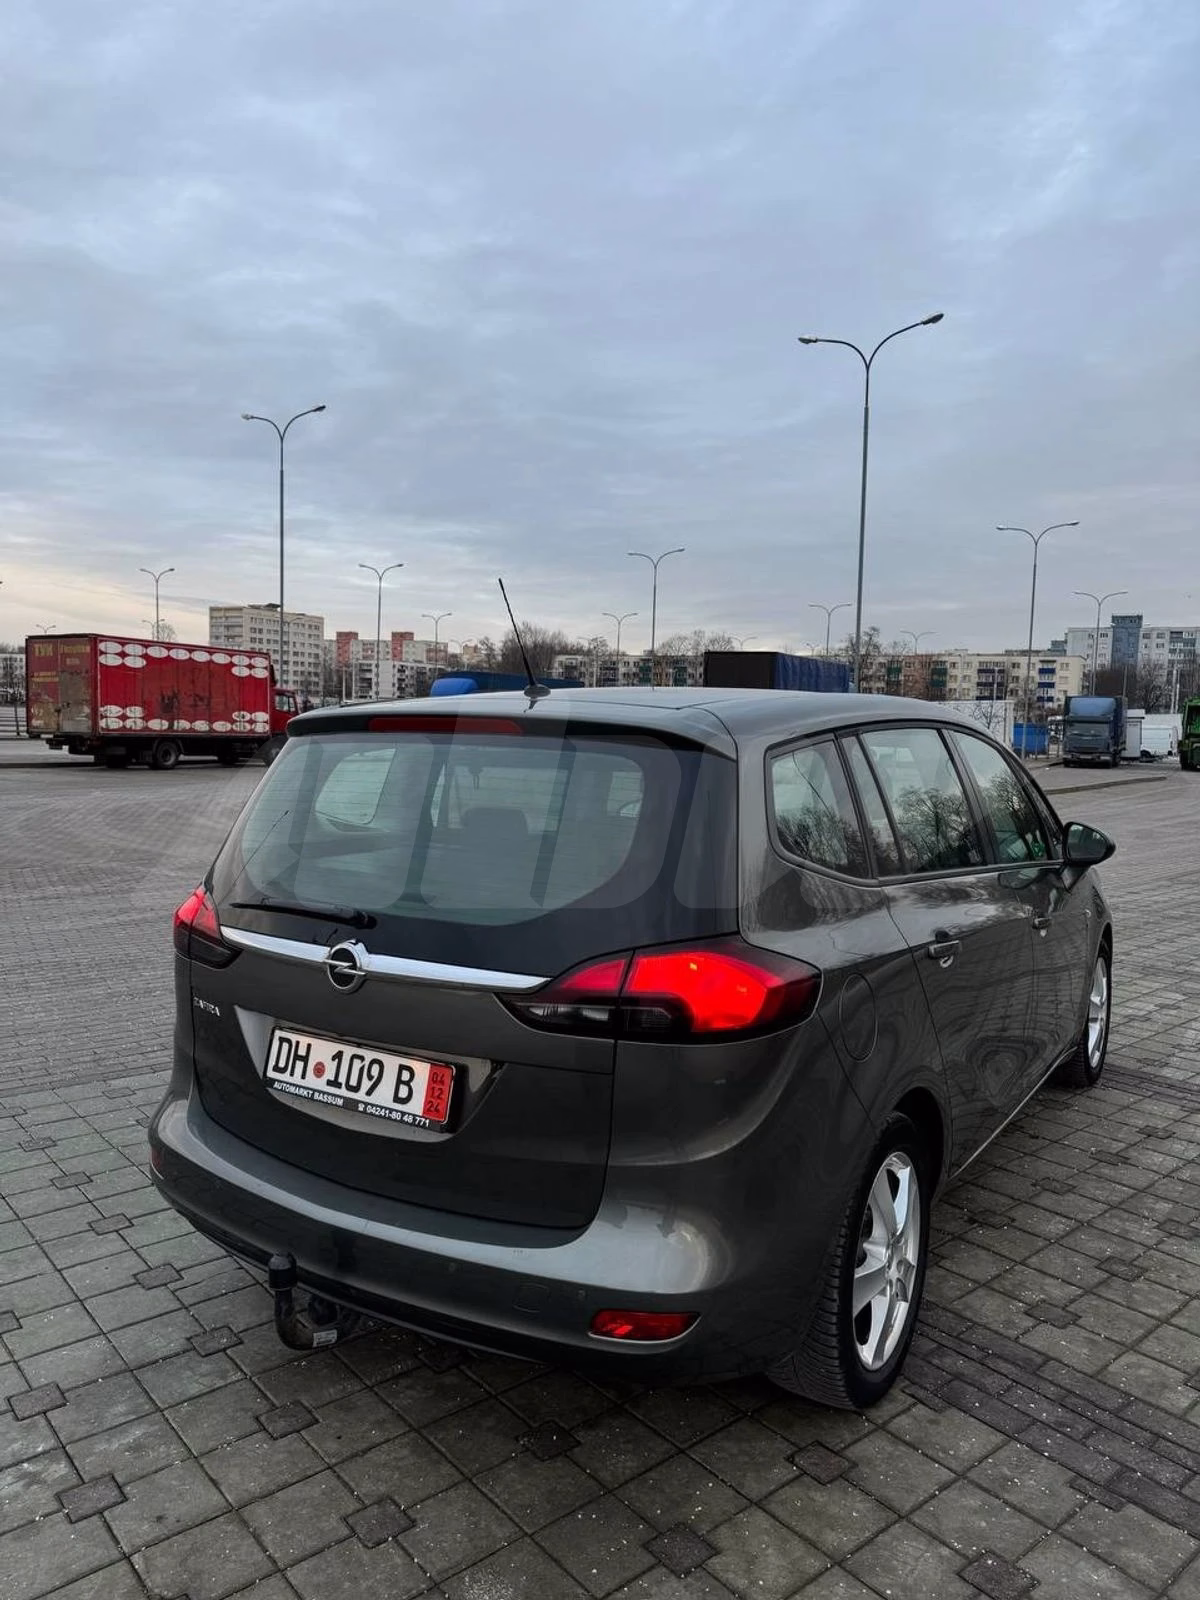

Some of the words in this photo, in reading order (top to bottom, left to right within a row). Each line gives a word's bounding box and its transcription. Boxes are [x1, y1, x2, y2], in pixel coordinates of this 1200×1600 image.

[272, 1036, 312, 1080] DH
[326, 1050, 385, 1097] 109
[392, 1063, 415, 1105] B
[431, 1072, 445, 1086] 04
[273, 1081, 313, 1098] AUTOMARKT
[314, 1092, 344, 1107] BASSUM
[430, 1087, 443, 1100] 12
[426, 1100, 440, 1114] 24
[415, 1116, 430, 1127] 771
